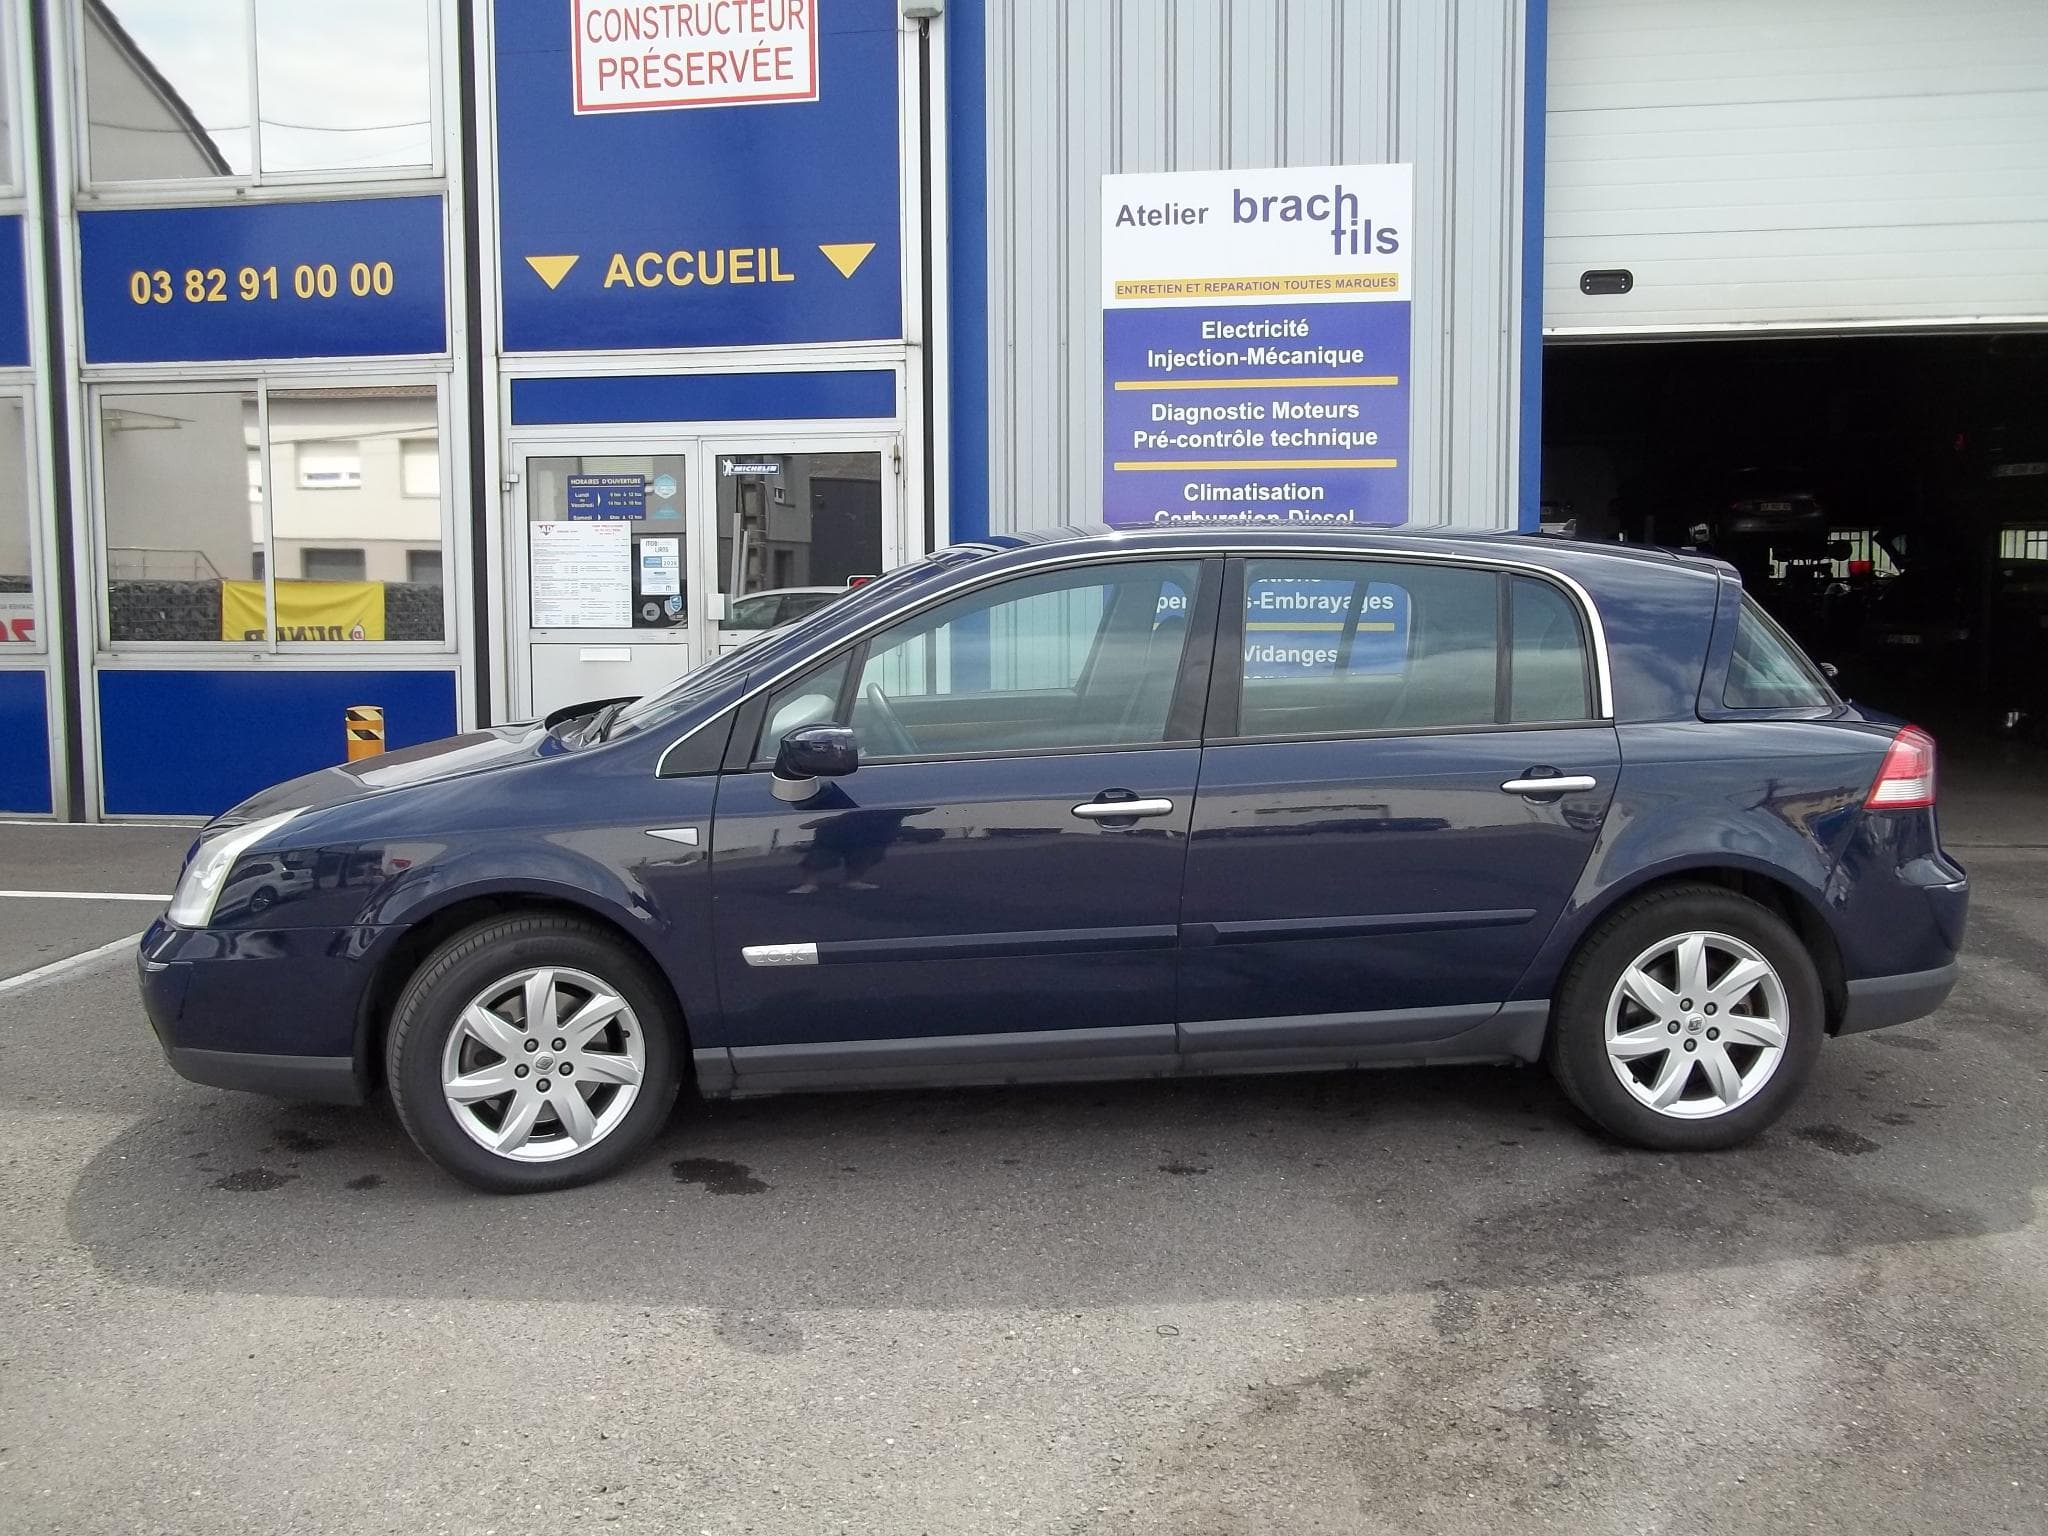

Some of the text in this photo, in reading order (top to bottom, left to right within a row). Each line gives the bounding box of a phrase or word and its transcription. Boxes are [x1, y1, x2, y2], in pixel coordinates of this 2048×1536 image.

[587, 0, 805, 43] CONSTRUCTEUR
[599, 39, 794, 91] PRÉSERVÉE
[1115, 184, 1358, 227] Atelier brach
[1331, 219, 1399, 255] fils
[603, 247, 795, 288] ACCUEIL
[130, 262, 393, 304] 03 82 91 00 00
[1117, 277, 1397, 295] ENTRETIEN ET REPARATION TOUTES MARQUES
[1202, 319, 1309, 339] Electricité
[1147, 346, 1364, 371] Injection-Mécanique
[1151, 401, 1360, 425] Diagnostic Moteurs
[1133, 428, 1378, 450] Pré-contrôle technique
[1184, 482, 1325, 501] Climatisation
[1244, 646, 1338, 666] Vidanges
